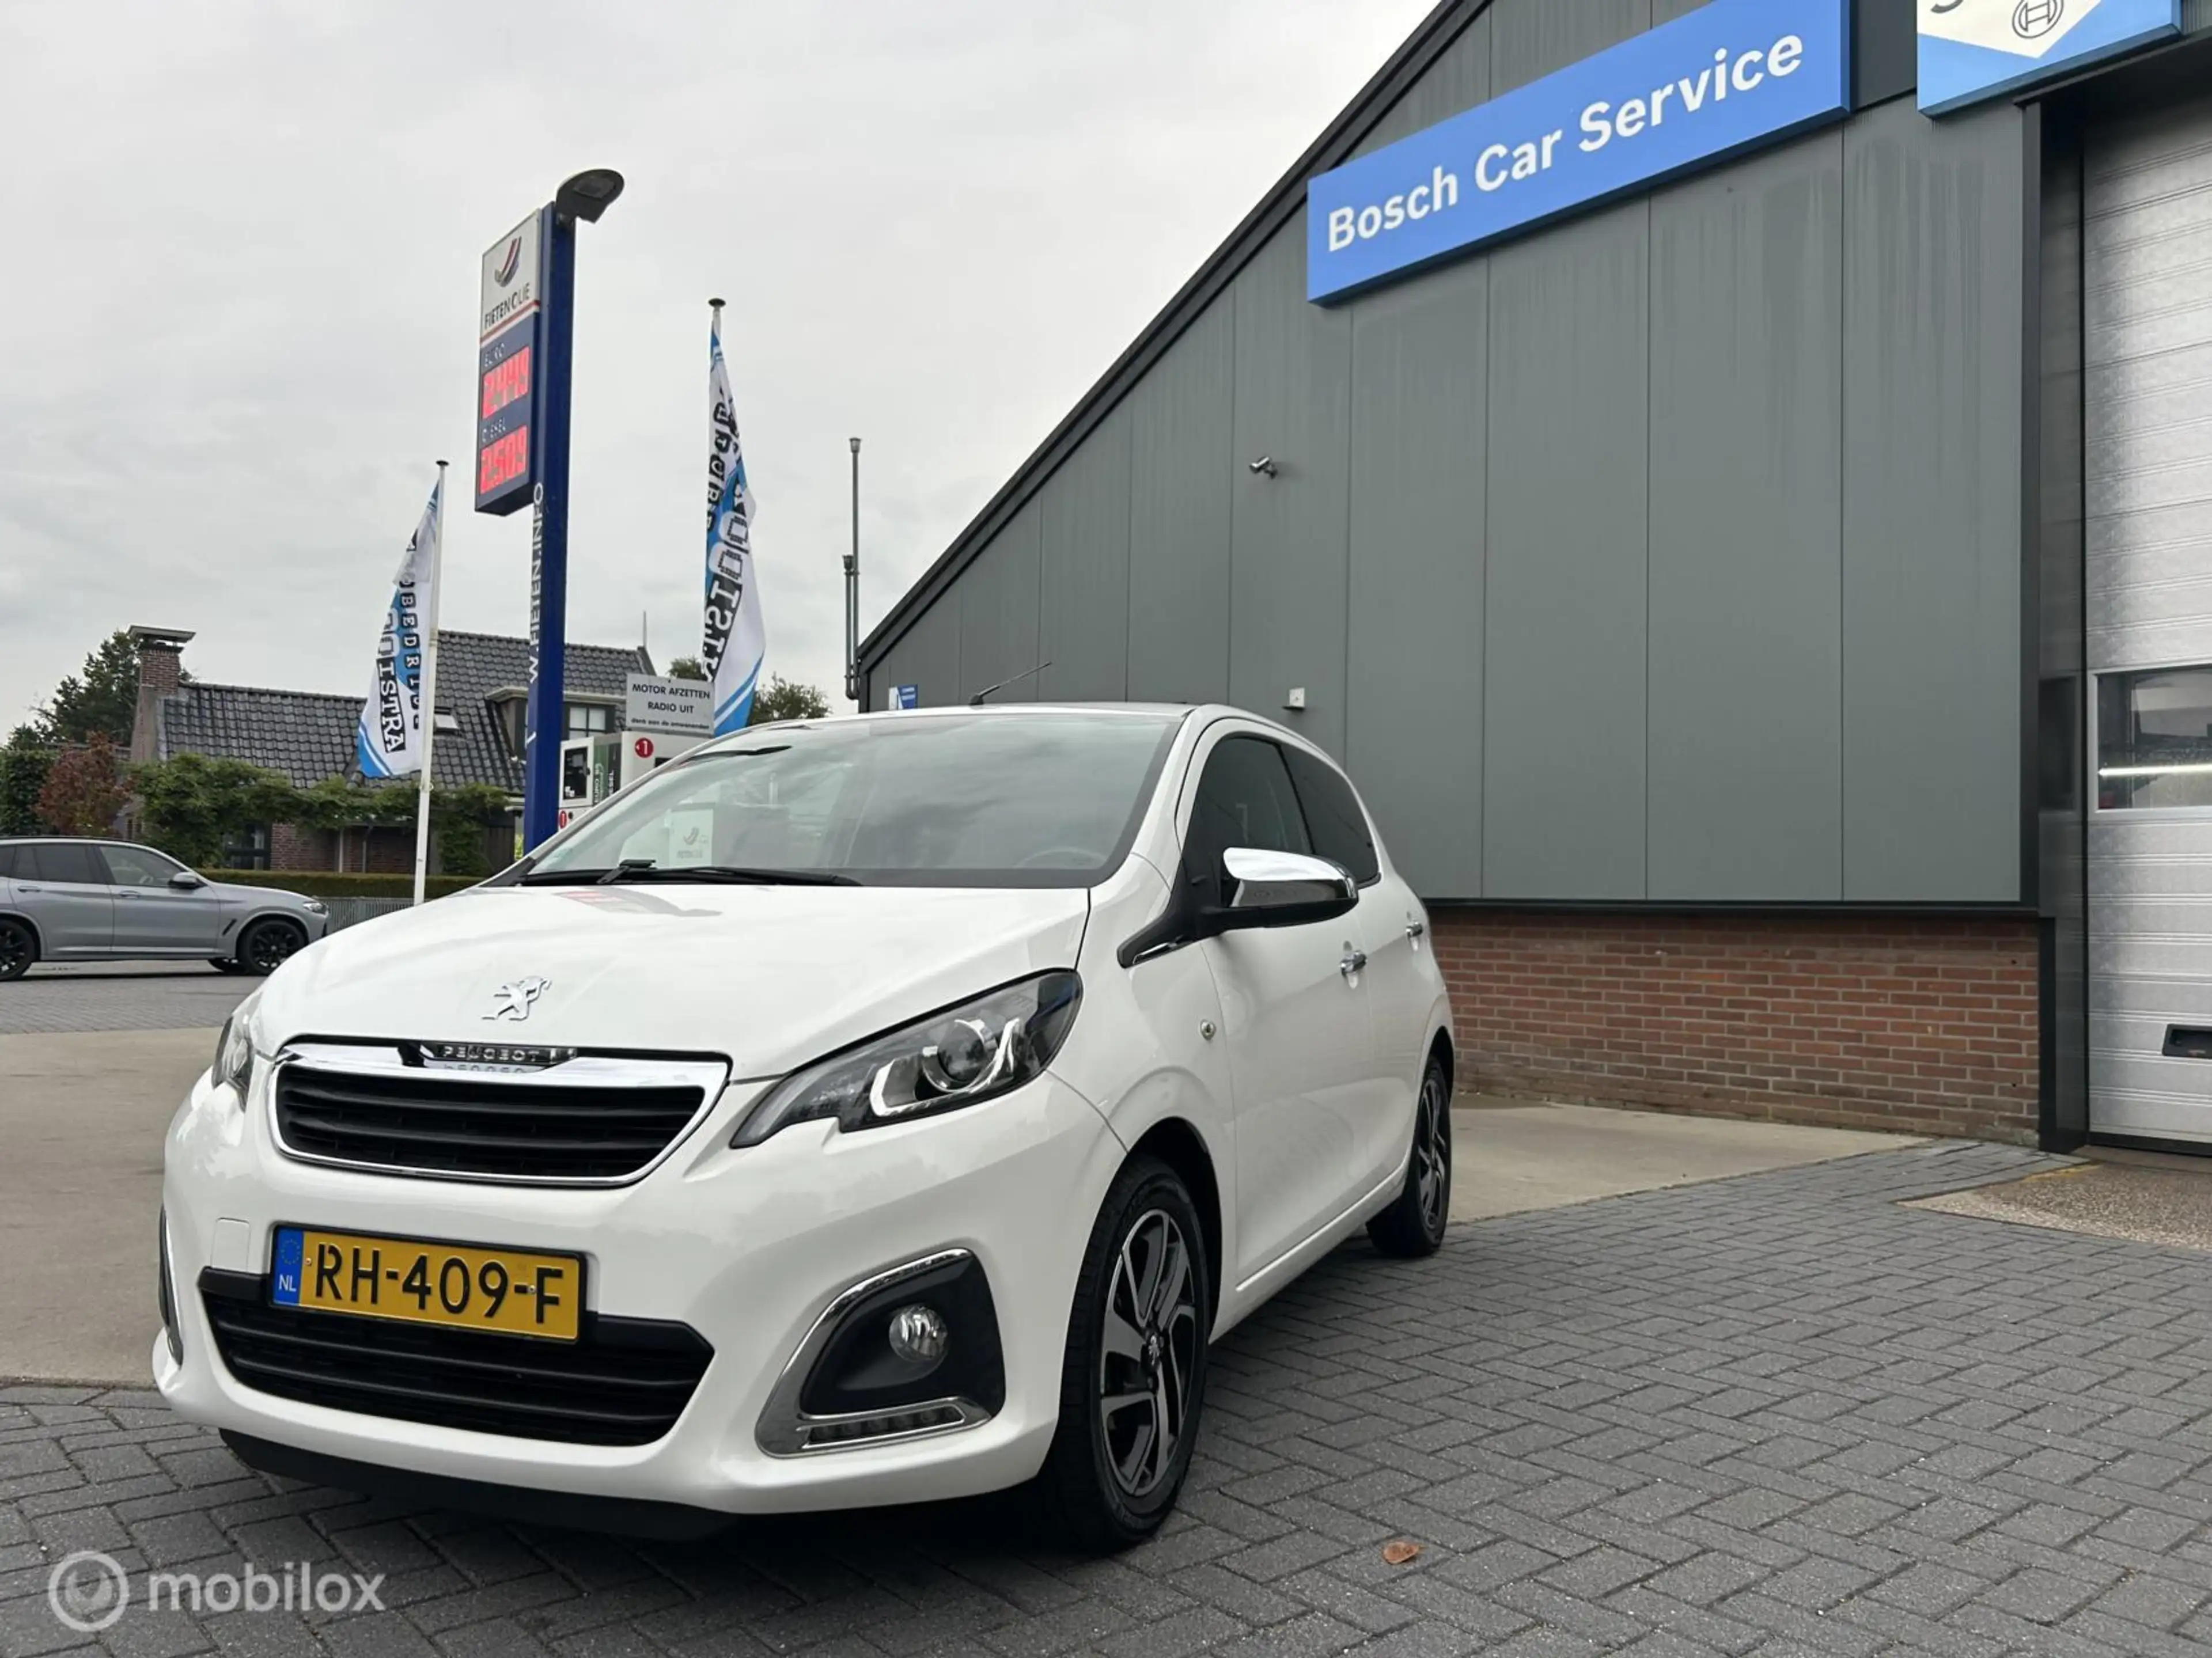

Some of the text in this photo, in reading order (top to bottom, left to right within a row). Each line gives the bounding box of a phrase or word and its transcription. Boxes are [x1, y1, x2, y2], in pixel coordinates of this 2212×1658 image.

[1328, 34, 1804, 253] Bosch Car Service
[632, 684, 710, 699] MOTOR AFZETTEN
[647, 701, 695, 714] RADIO UIT
[642, 739, 648, 755] 1
[442, 1045, 540, 1063] PEUGEOT
[278, 1273, 297, 1293] NL
[315, 1243, 564, 1325] RH-409-F
